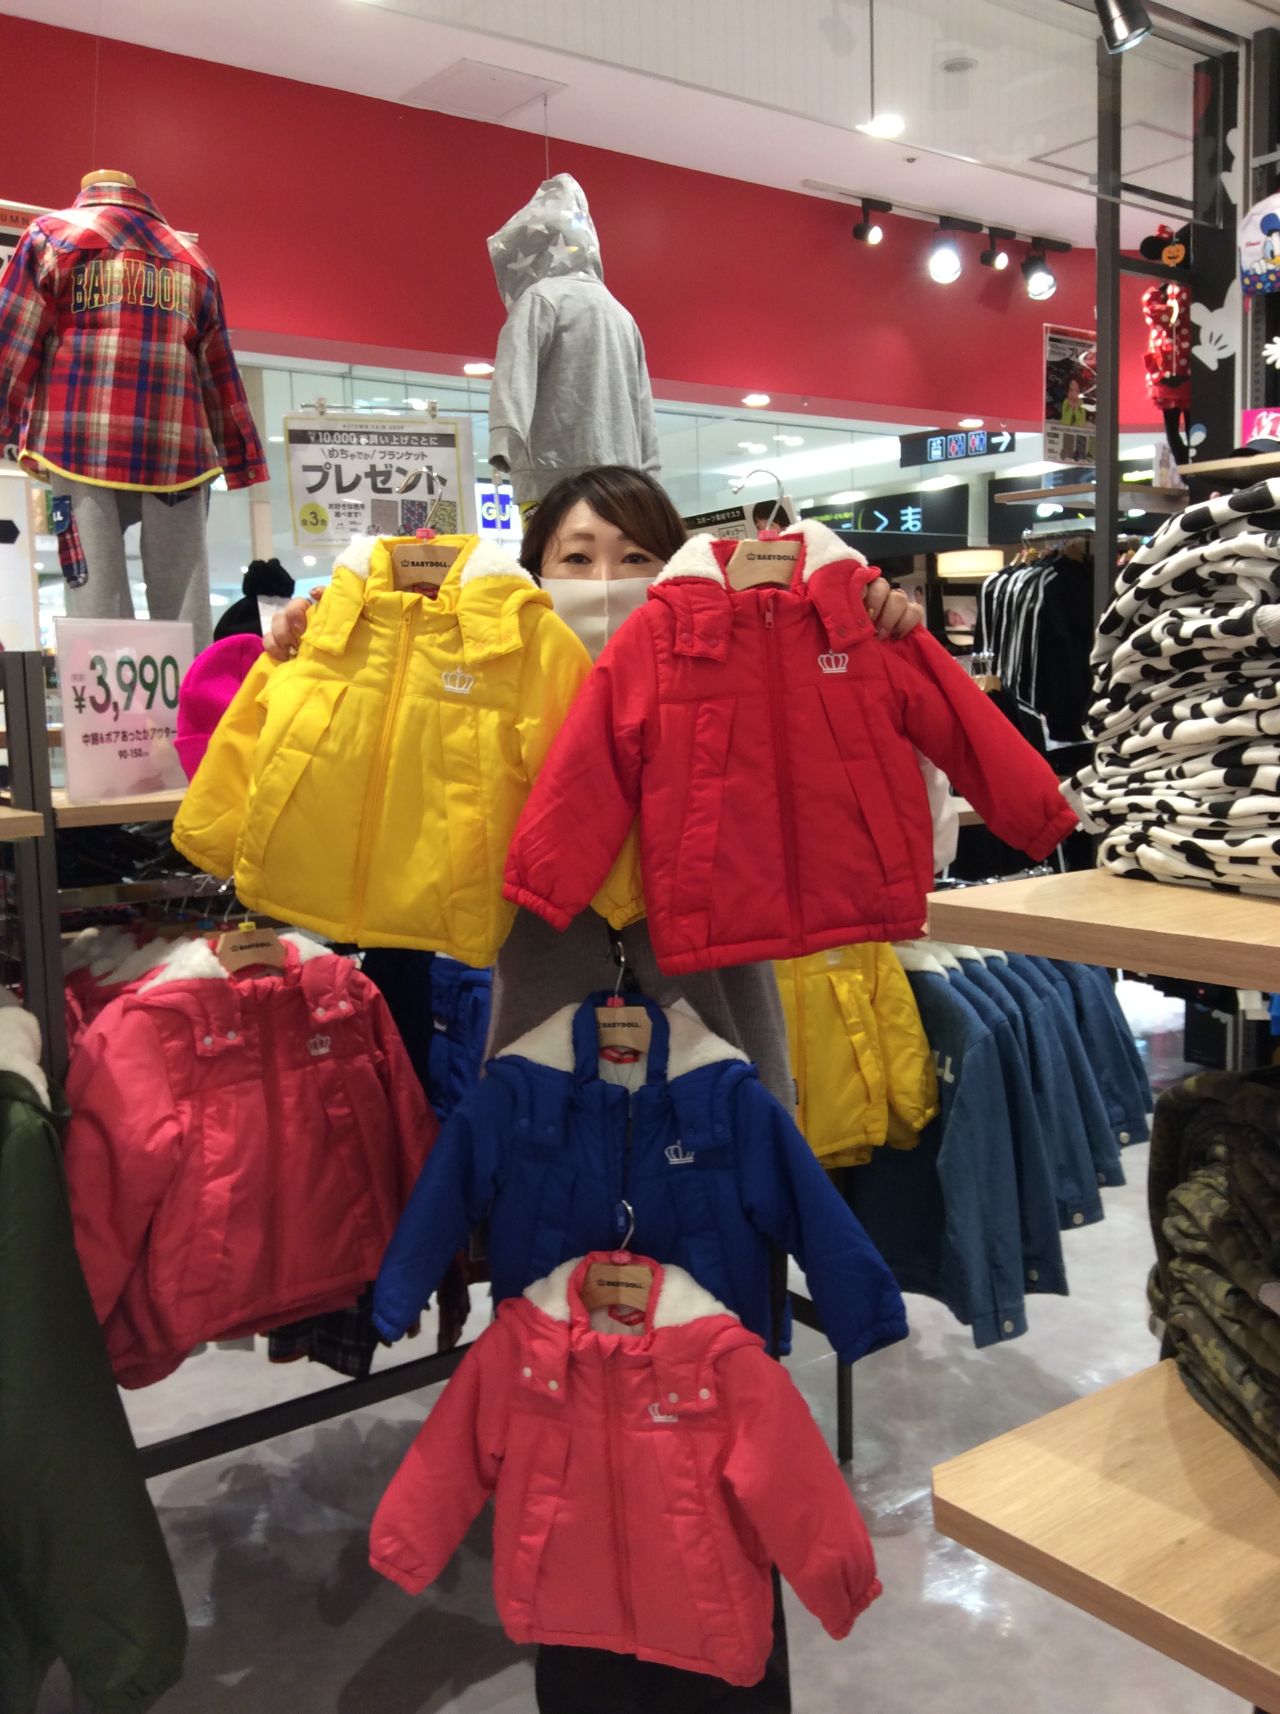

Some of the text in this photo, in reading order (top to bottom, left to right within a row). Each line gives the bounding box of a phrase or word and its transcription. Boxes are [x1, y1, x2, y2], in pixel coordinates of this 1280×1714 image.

[71, 258, 196, 317] BABYDOL
[301, 461, 448, 495] プレゼント
[481, 501, 511, 521] GU
